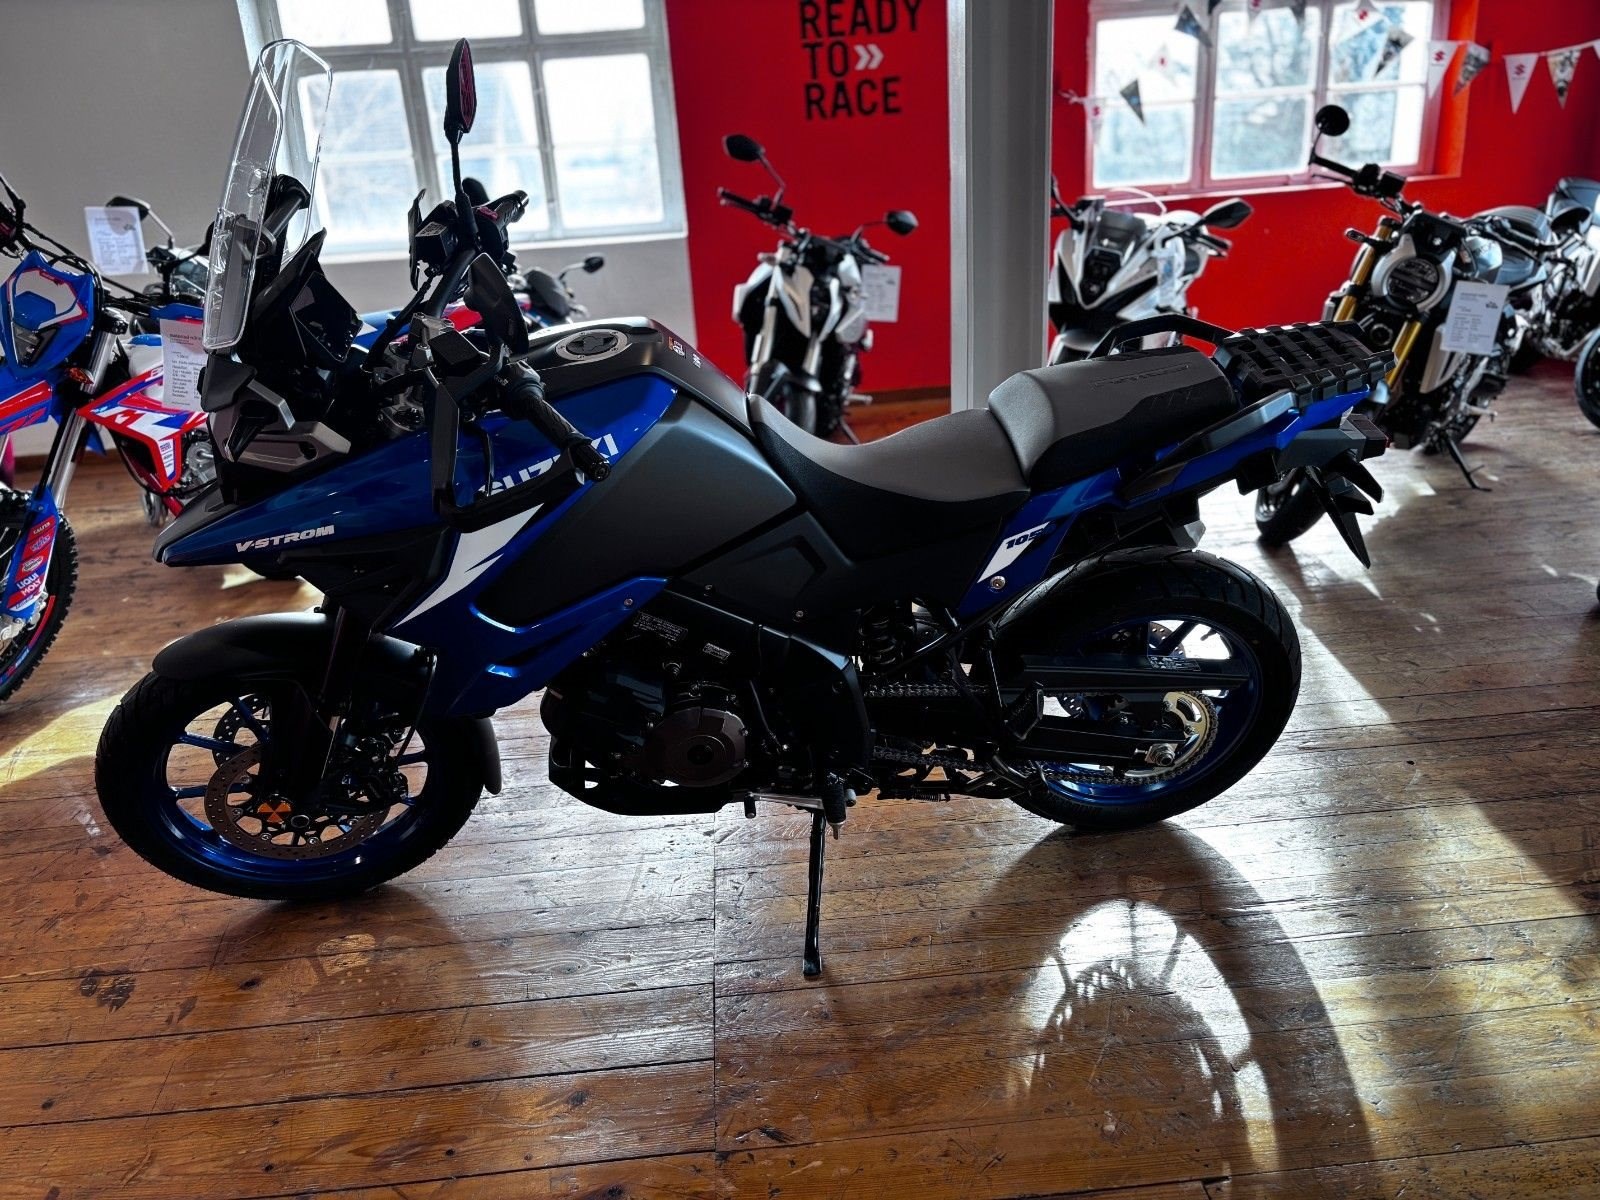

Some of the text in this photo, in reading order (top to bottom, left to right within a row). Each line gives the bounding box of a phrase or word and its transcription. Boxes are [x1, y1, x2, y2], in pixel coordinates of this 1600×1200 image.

[800, 0, 921, 39] READY
[803, 41, 849, 80] TO
[805, 76, 902, 120] RACE
[478, 433, 619, 496] SUZI
[236, 525, 334, 552] V-STROM
[16, 573, 39, 589] LIQUI
[21, 579, 41, 596] MOLY
